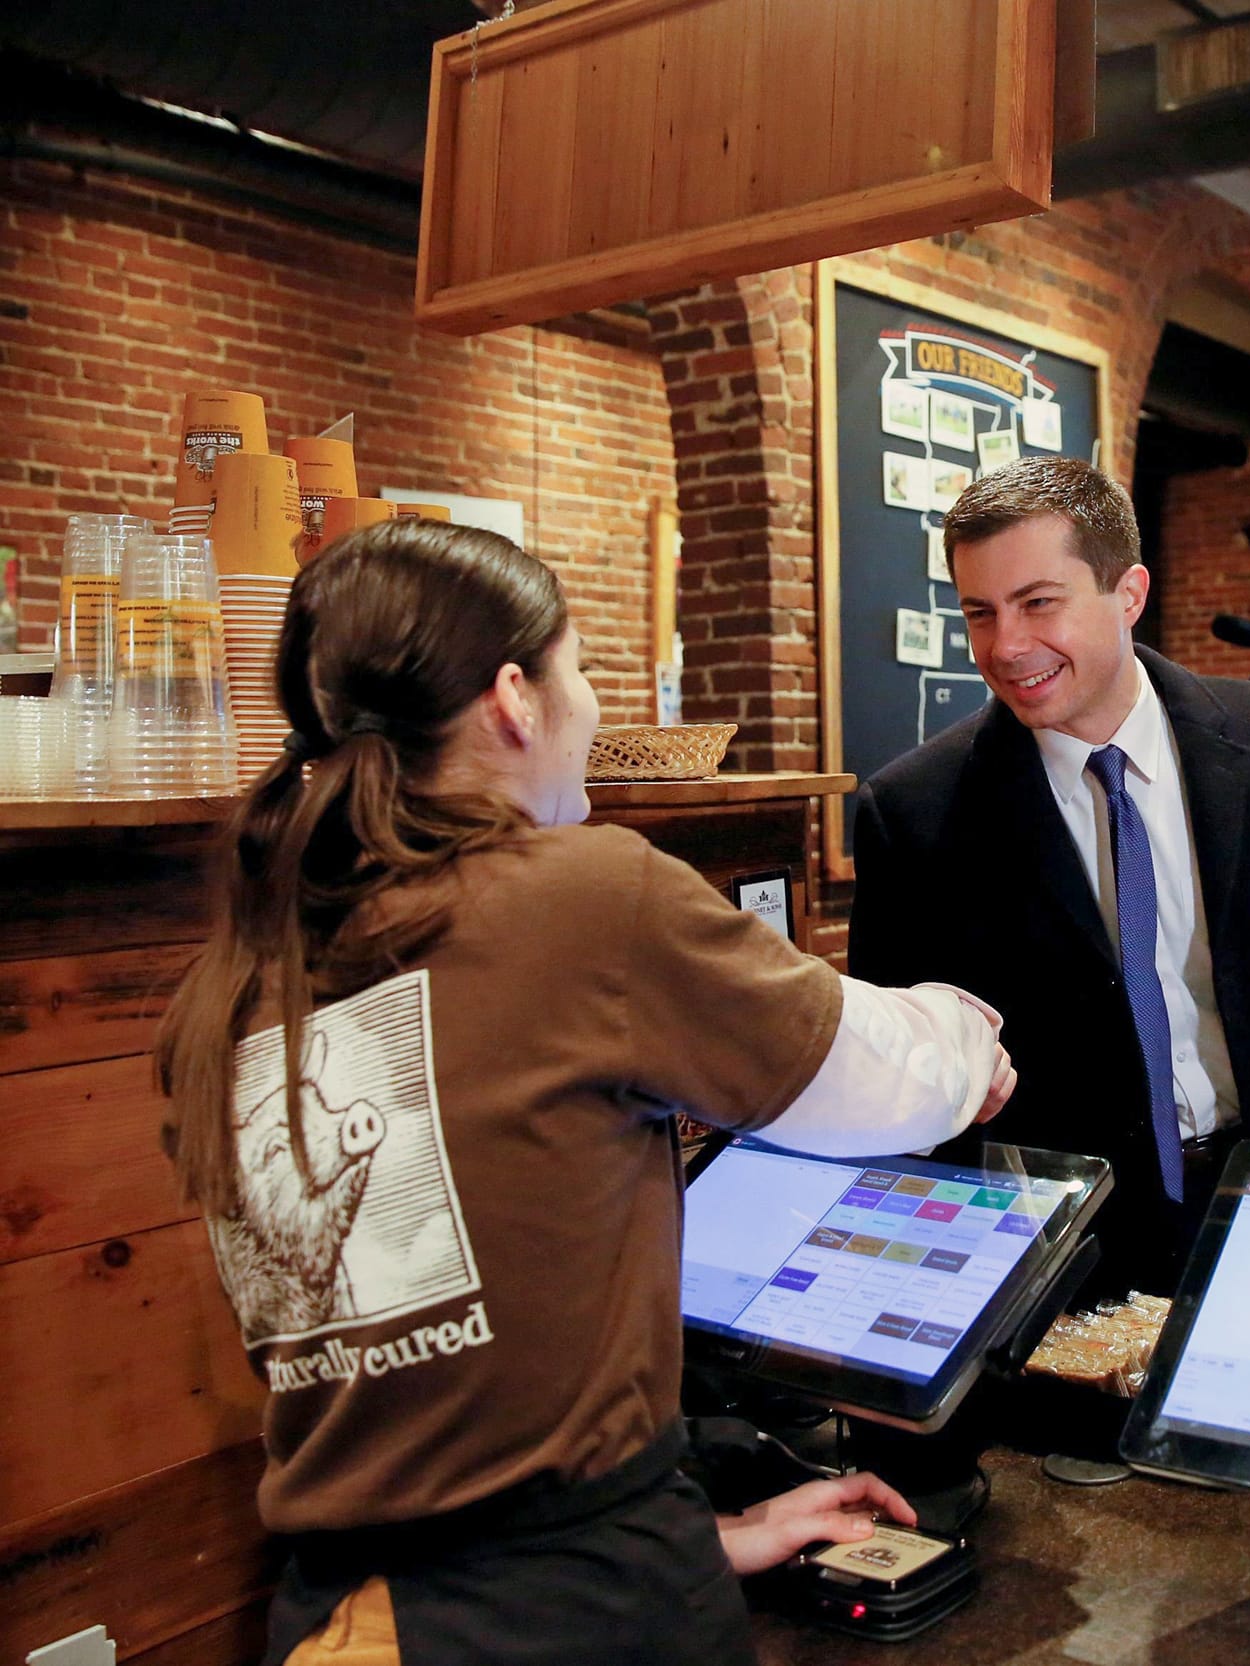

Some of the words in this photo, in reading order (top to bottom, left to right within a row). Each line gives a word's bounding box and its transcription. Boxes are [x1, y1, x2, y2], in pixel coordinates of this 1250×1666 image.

[918, 341, 956, 372] OUR
[958, 349, 1025, 397] FRIENDS
[186, 436, 218, 446] works
[219, 436, 241, 446] the
[300, 500, 325, 508] wor
[265, 1338, 361, 1393] turally
[363, 1301, 495, 1378] cured
